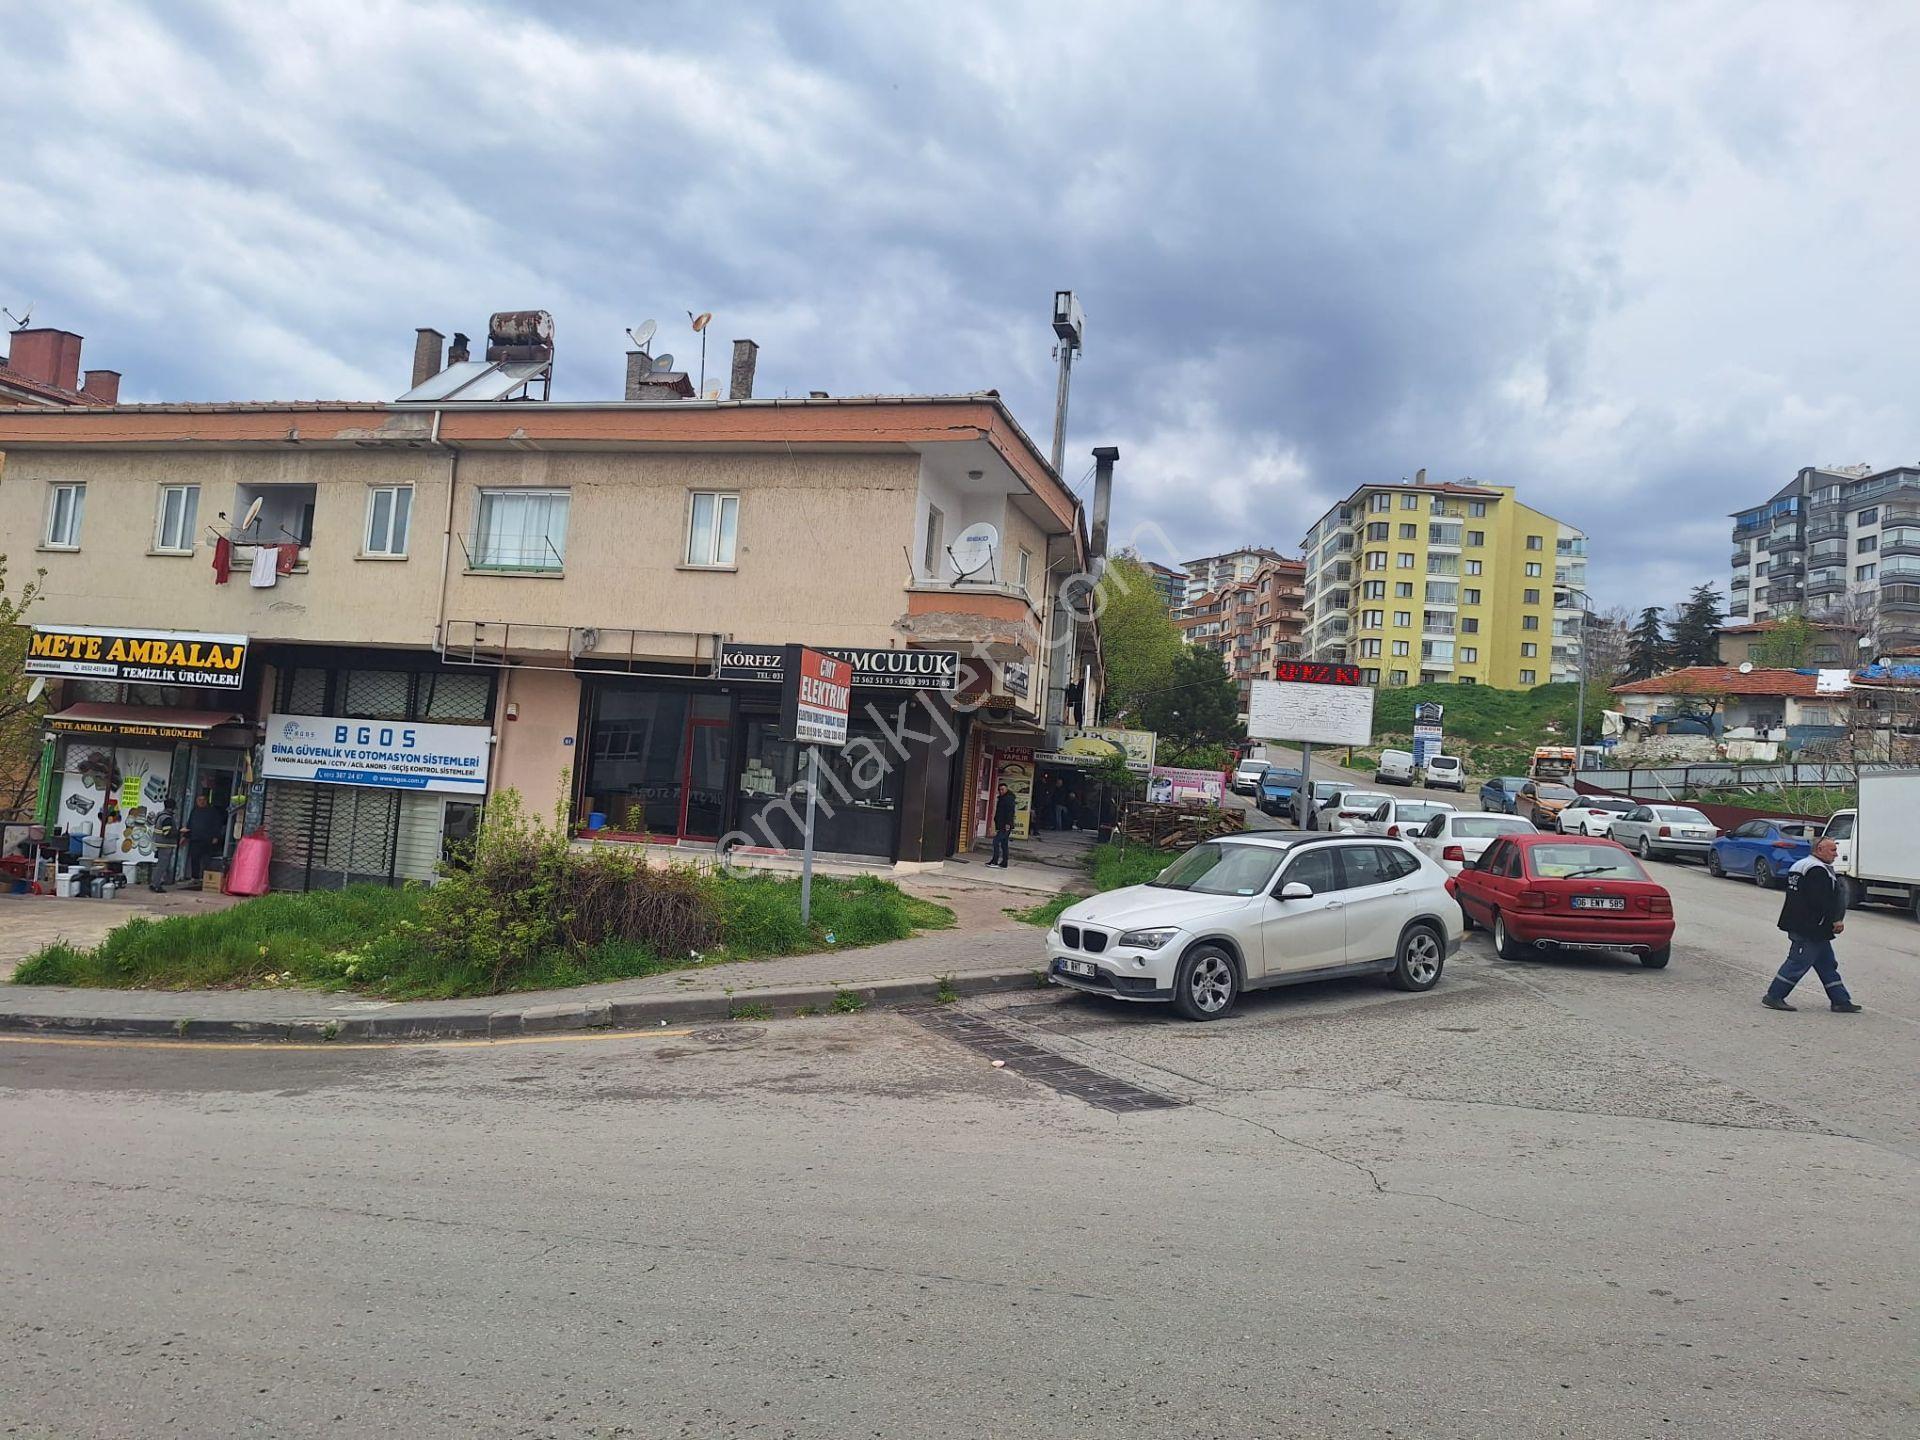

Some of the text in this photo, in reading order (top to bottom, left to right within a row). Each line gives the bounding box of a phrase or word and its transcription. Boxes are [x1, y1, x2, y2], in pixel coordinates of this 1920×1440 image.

[30, 634, 243, 669] METE AMBALAJ
[722, 651, 782, 667] KÖRFEZ
[122, 667, 240, 685] TEMİZLİK ÜRÜNLERİ
[74, 723, 113, 733] AMBALAJ
[120, 726, 157, 735] TEMİZLİK
[160, 728, 203, 739] ÜRÜNLERİ
[271, 742, 480, 767] BİNA GÜVENLİK VE OTOMASYON SİSTEMLERİ
[1577, 898, 1586, 907] 06
[1590, 899, 1604, 907] ENY
